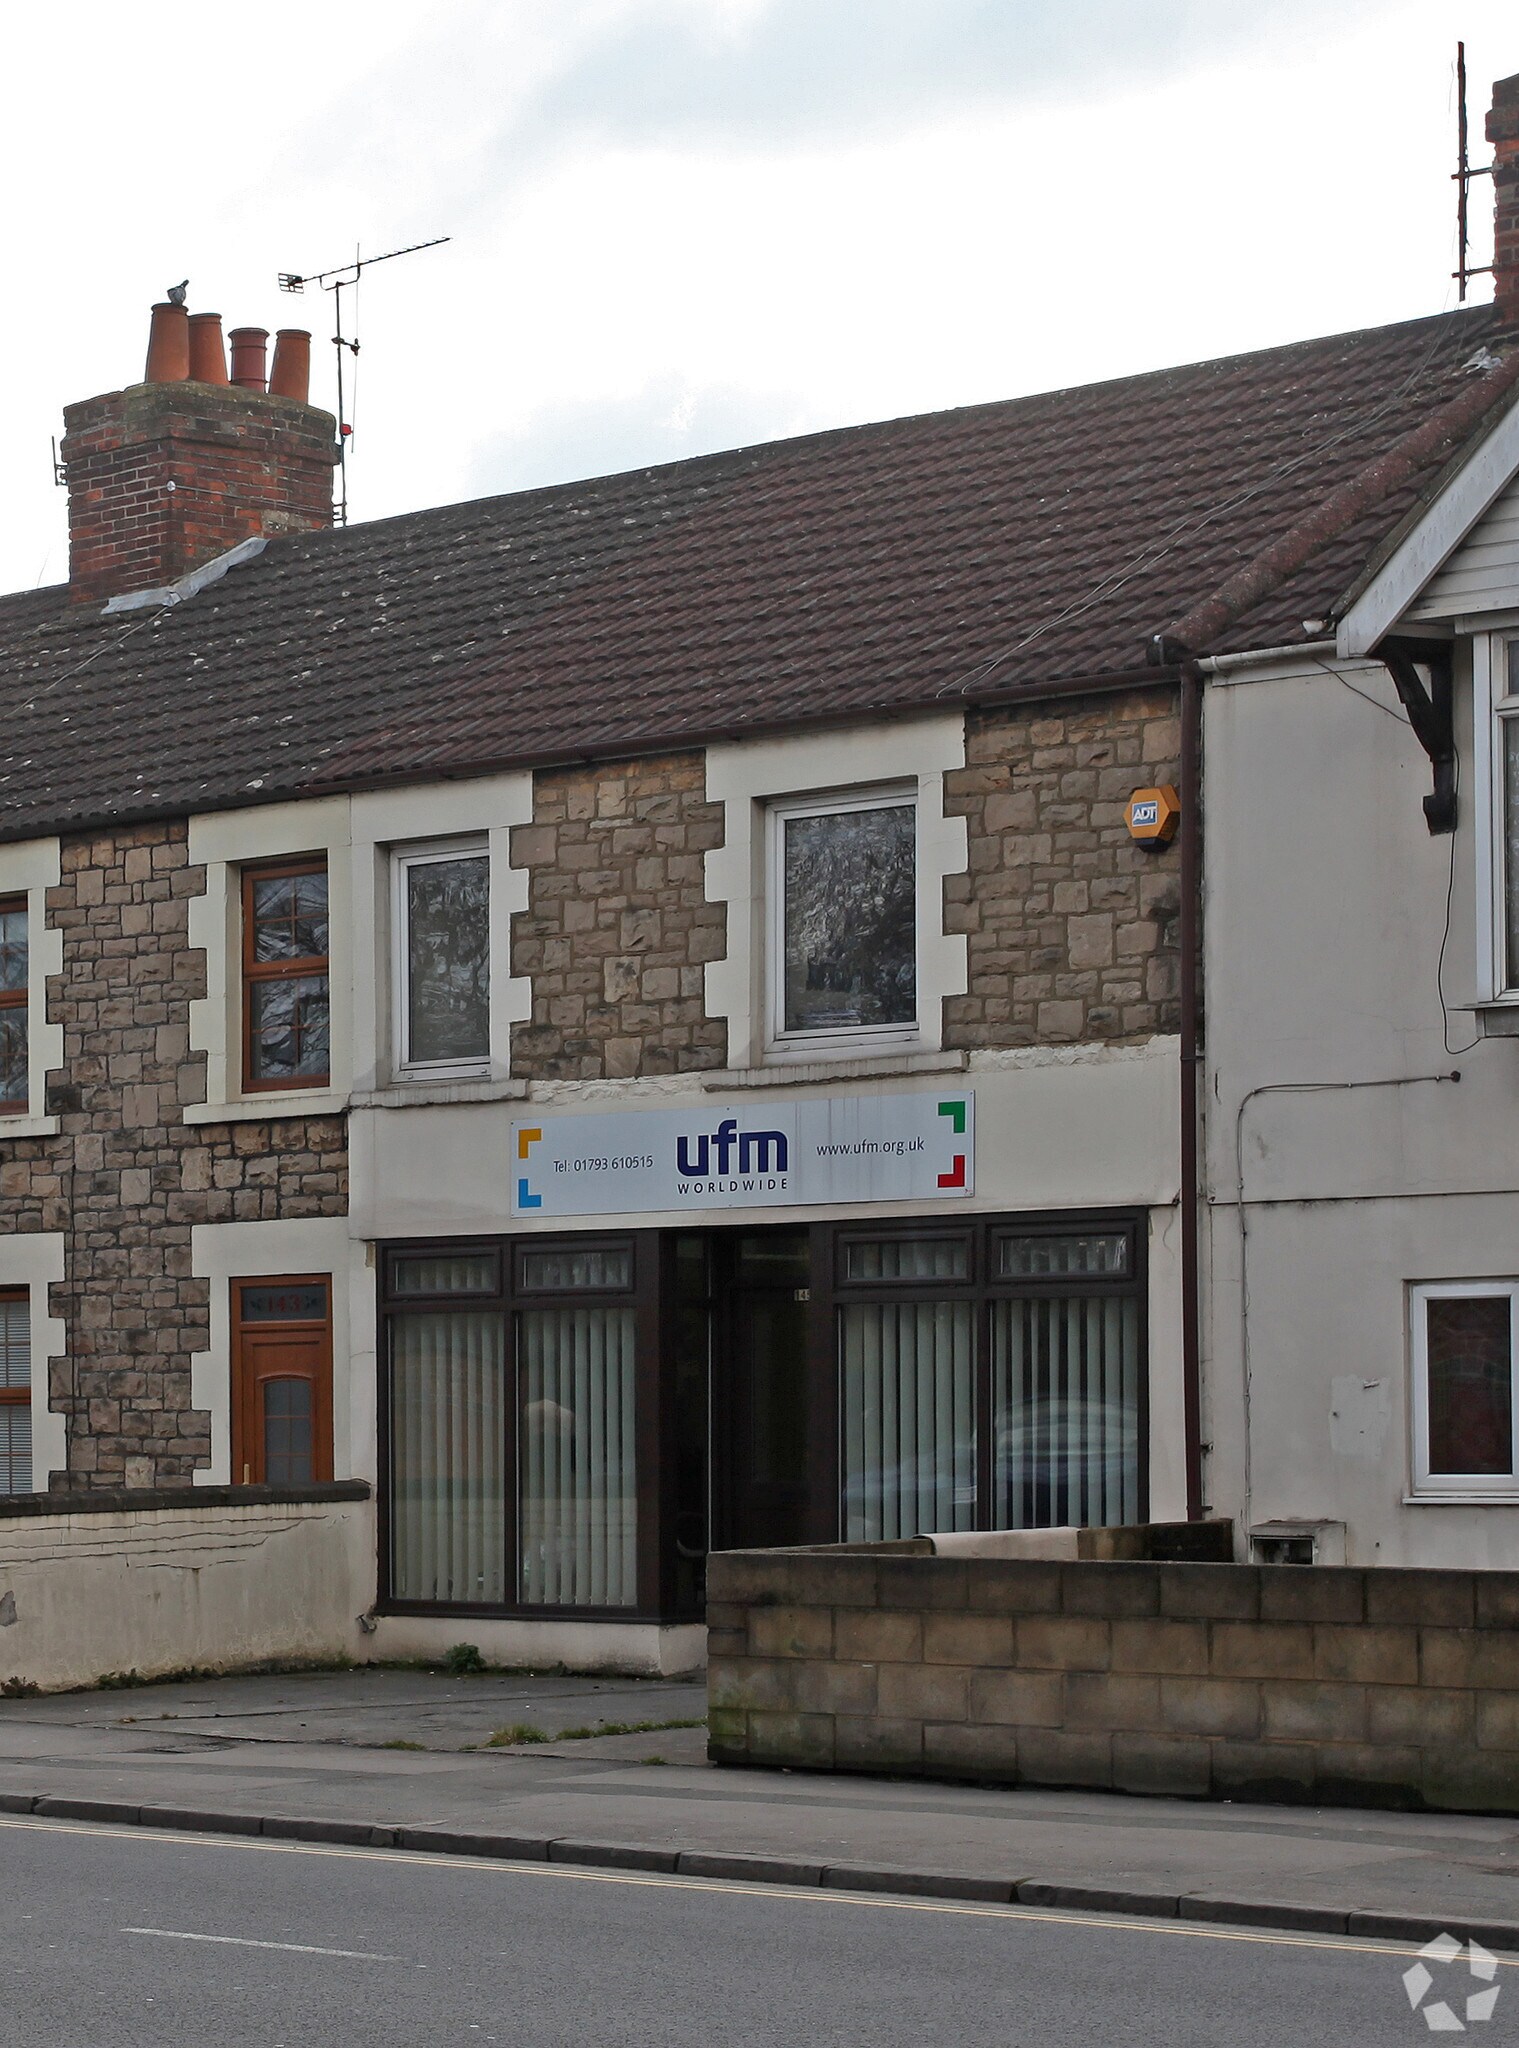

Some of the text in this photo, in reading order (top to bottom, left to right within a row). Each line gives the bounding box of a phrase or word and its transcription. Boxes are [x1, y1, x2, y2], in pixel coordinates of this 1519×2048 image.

[1132, 805, 1158, 821] ADT
[677, 1119, 788, 1177] ufm
[816, 1136, 925, 1156] www.ufm.org.uk
[553, 1155, 654, 1173] Tel: 01793 610515
[677, 1178, 788, 1195] WORLDWIDE
